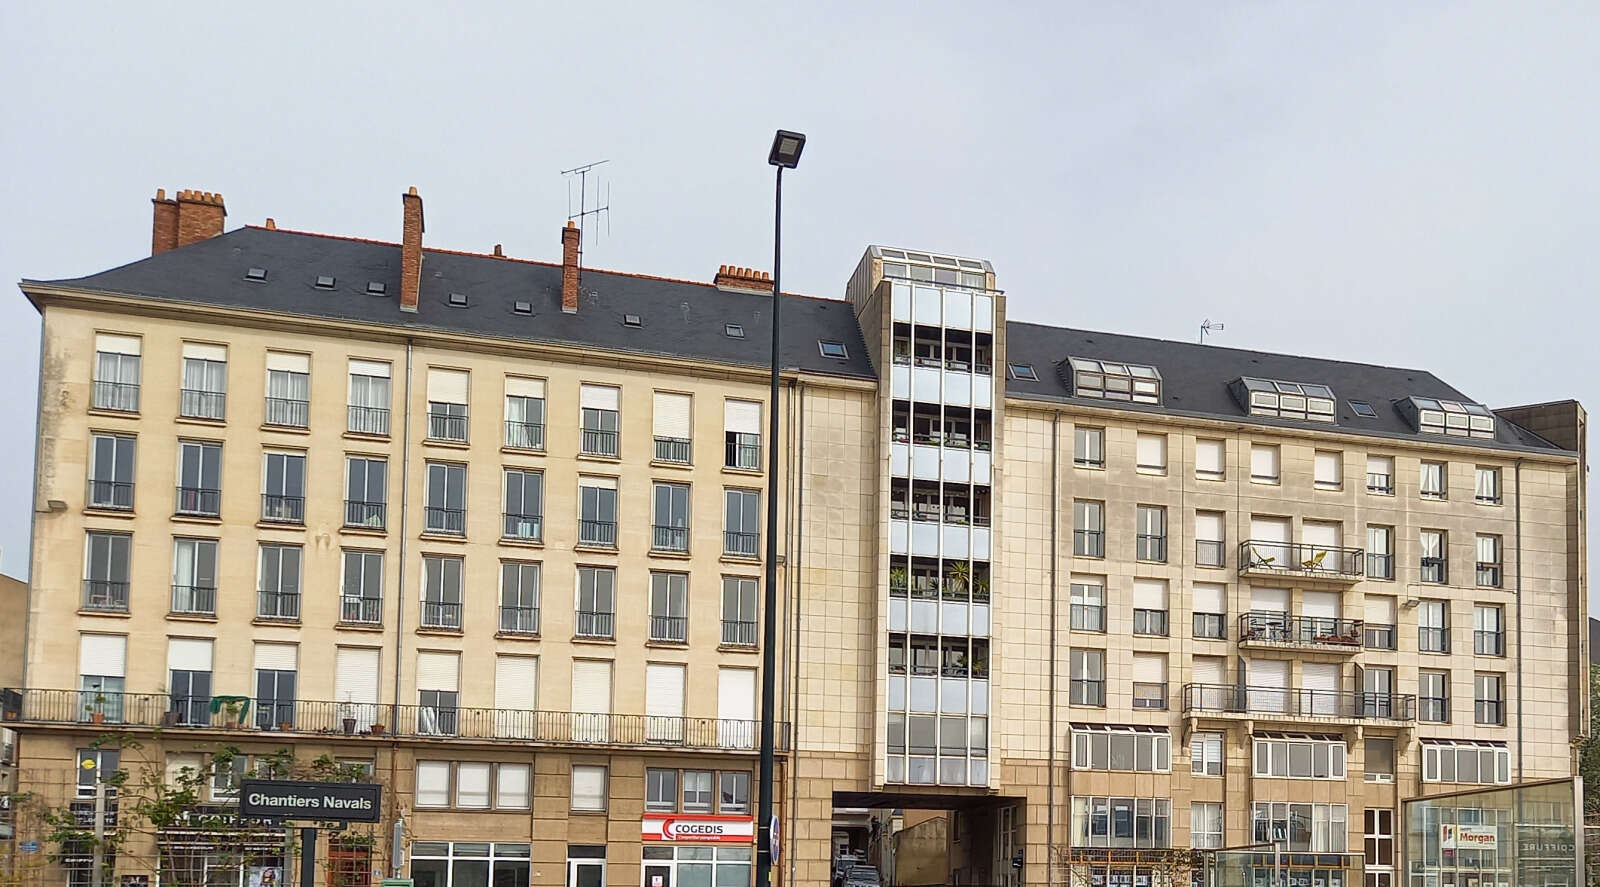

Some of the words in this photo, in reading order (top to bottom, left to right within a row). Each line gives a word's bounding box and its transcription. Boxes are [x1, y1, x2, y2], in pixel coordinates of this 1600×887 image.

[248, 793, 320, 808] Chantiers
[323, 796, 372, 810] Navals
[675, 824, 724, 834] COGEDIS
[1459, 832, 1495, 844] Morgan
